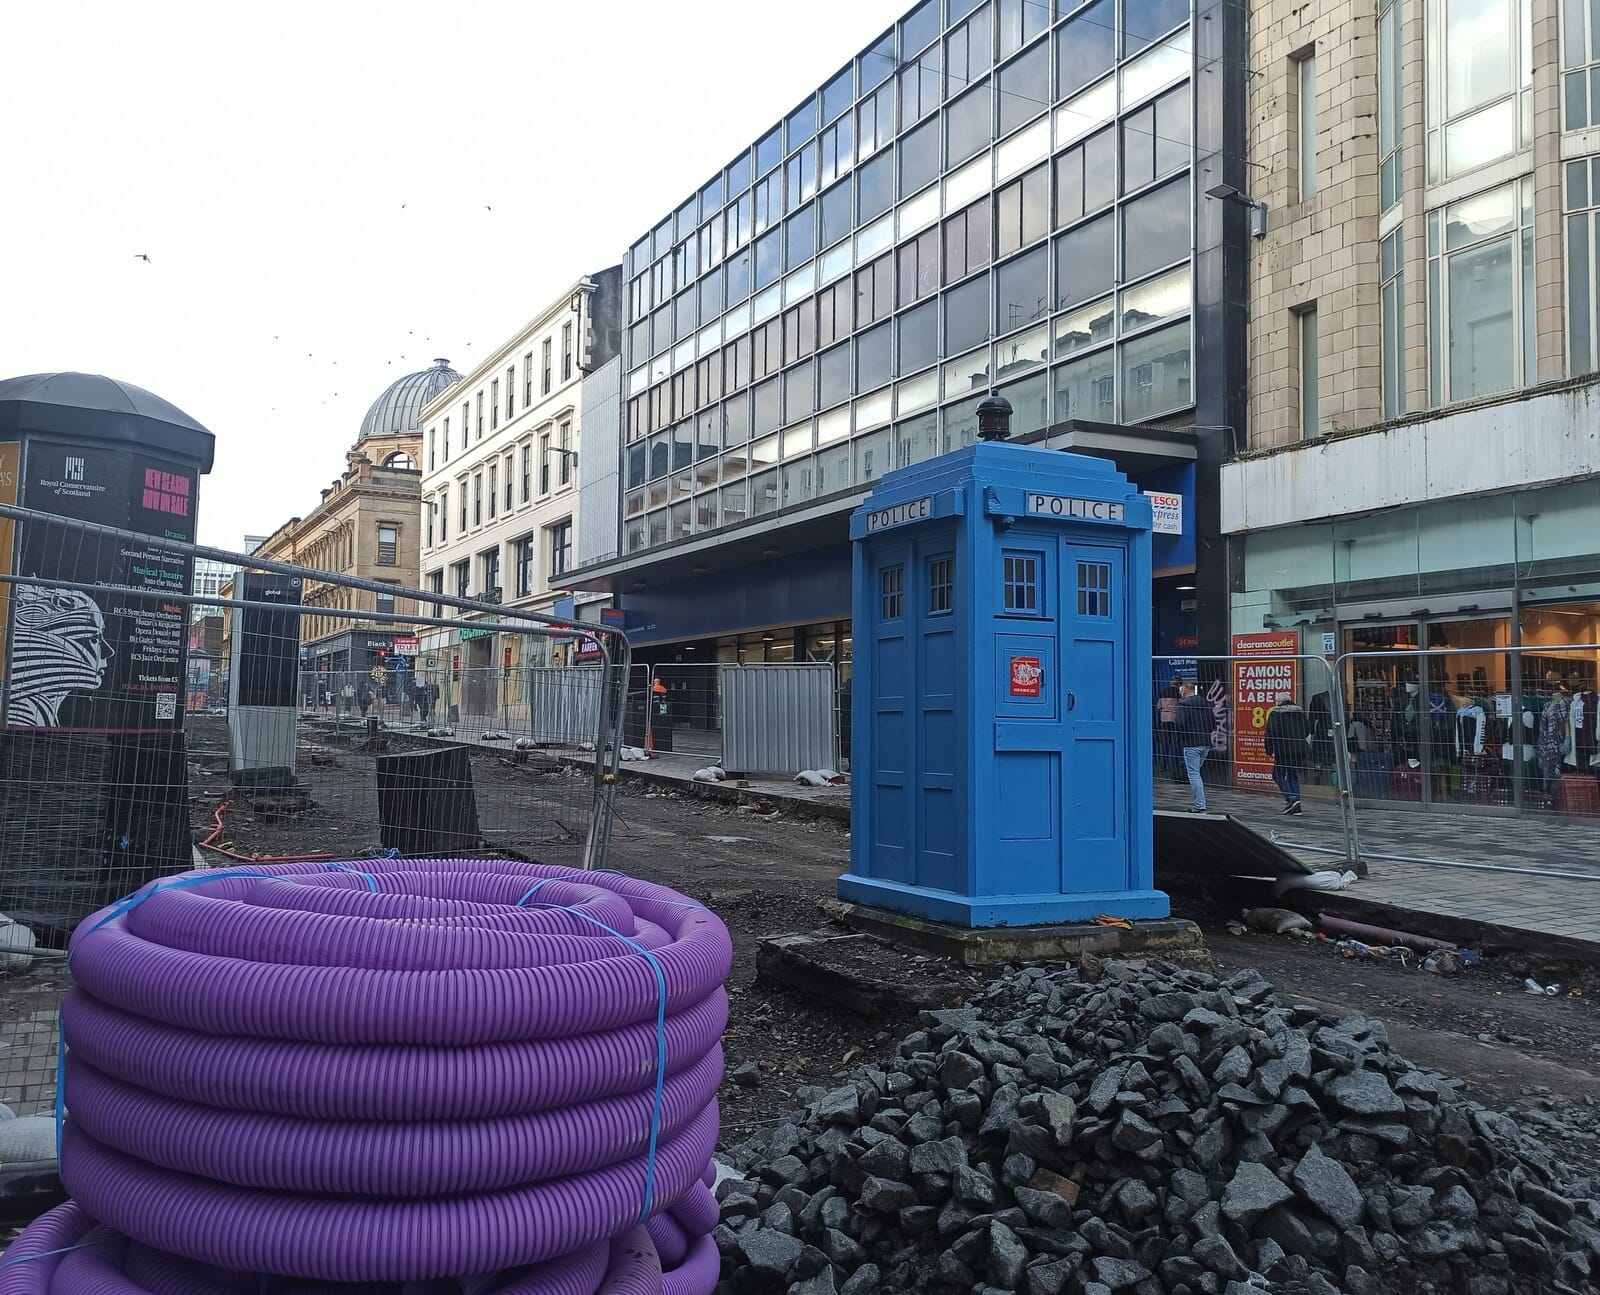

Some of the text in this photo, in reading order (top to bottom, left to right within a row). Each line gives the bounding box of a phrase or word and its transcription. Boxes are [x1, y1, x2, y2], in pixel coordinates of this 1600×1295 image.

[40, 479, 106, 492] Royal Conservatoire
[145, 468, 189, 496] NEW SEASON
[62, 488, 91, 497] Scotland
[143, 489, 188, 516] NOW ON SALE
[1149, 495, 1179, 506] TESCO
[1036, 496, 1116, 520] POLICE
[872, 500, 926, 529] POLICE
[1152, 510, 1179, 520] xpress
[165, 529, 186, 540] Drama
[120, 548, 142, 559] Second
[143, 553, 160, 561] Person
[161, 555, 184, 565] Narrative
[133, 566, 184, 580] Musical Theatre
[157, 578, 165, 586] the
[113, 607, 181, 620] RCS Symphony Orchestra
[163, 604, 182, 613] Music
[143, 645, 162, 654] Fridays
[154, 655, 179, 663] Orchestra
[1239, 665, 1291, 678] FAMOUS
[138, 674, 156, 682] Tickets
[1239, 678, 1291, 690] FASHION
[1239, 691, 1291, 703] LABEL
